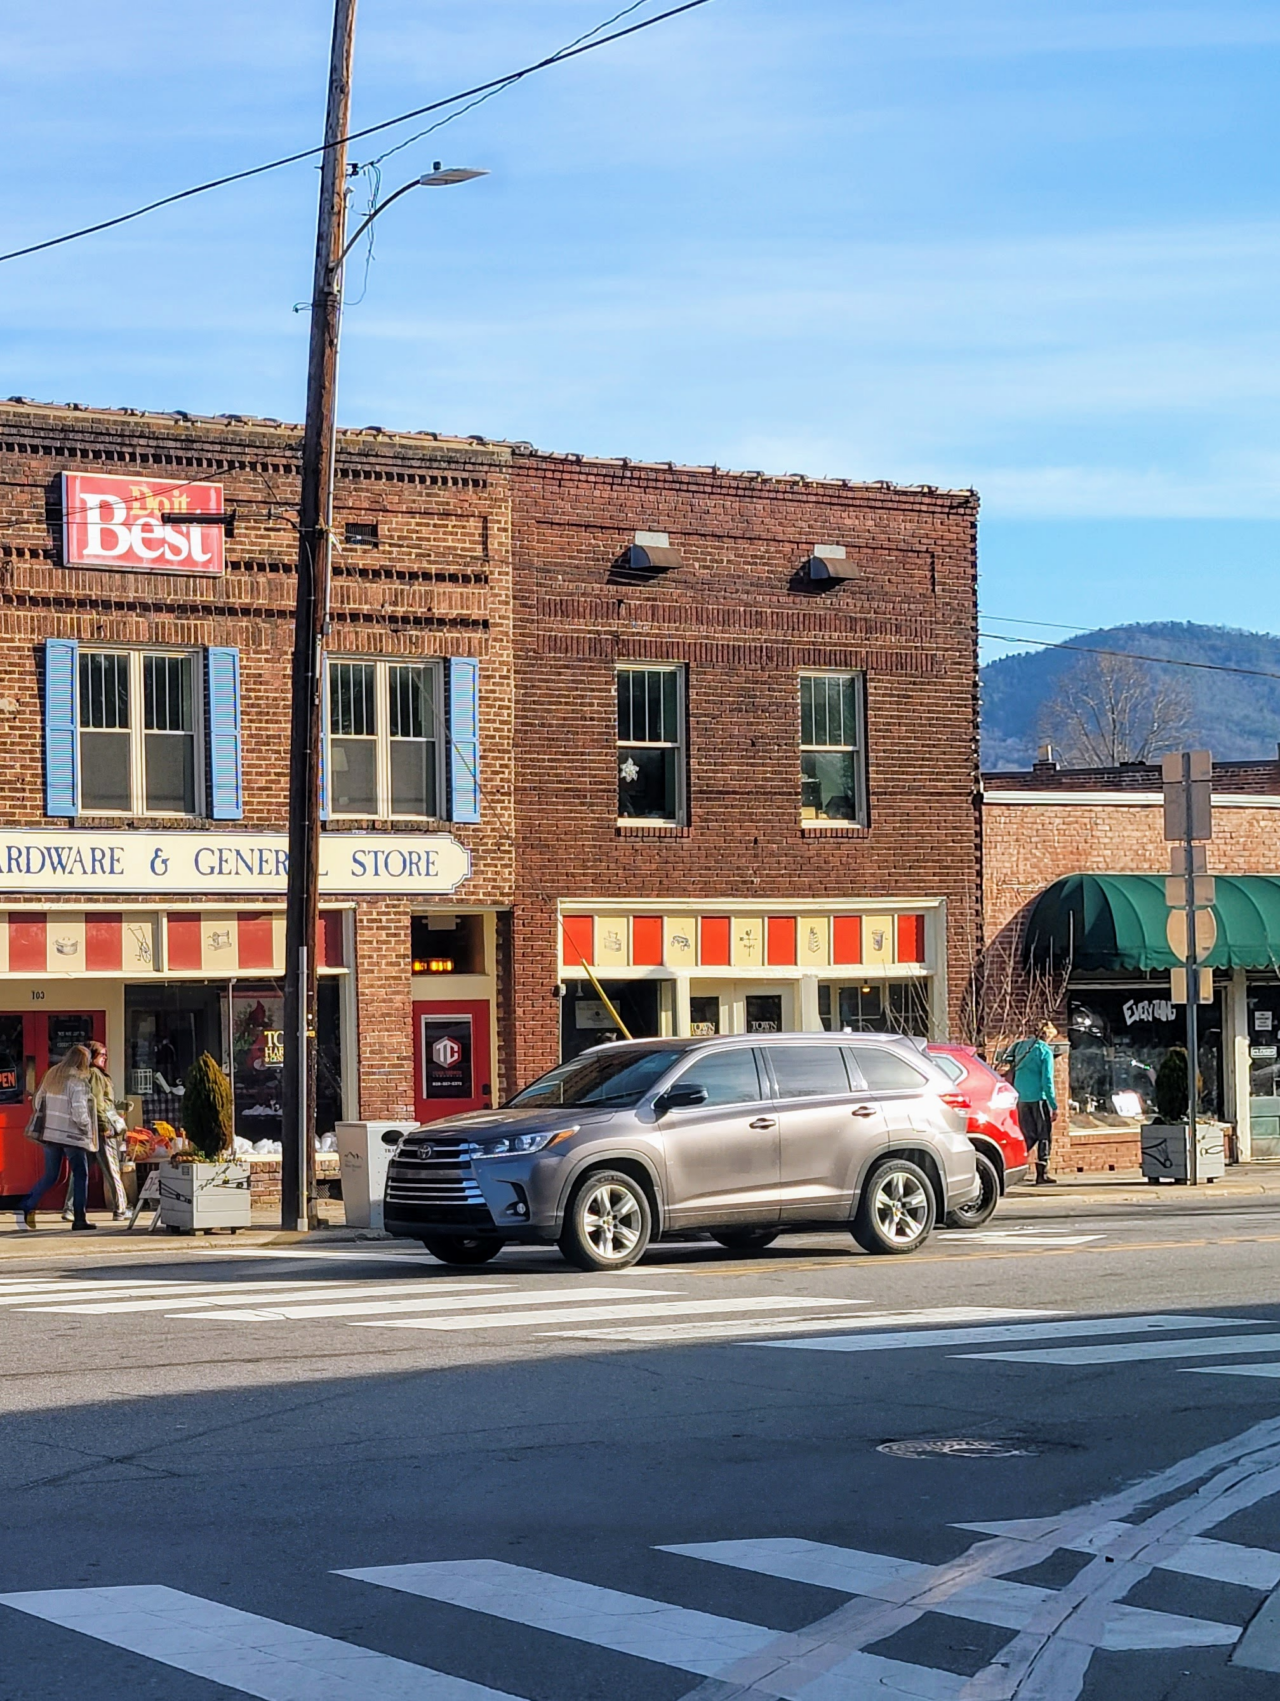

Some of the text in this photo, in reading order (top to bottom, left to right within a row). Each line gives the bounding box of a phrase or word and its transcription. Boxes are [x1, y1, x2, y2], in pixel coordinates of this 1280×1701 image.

[129, 485, 191, 515] Do it
[79, 493, 212, 562] Best
[150, 847, 169, 876] &
[194, 848, 328, 877] GENER
[351, 849, 439, 877] STORE
[31, 991, 45, 1000] 103
[264, 1031, 284, 1047] TO
